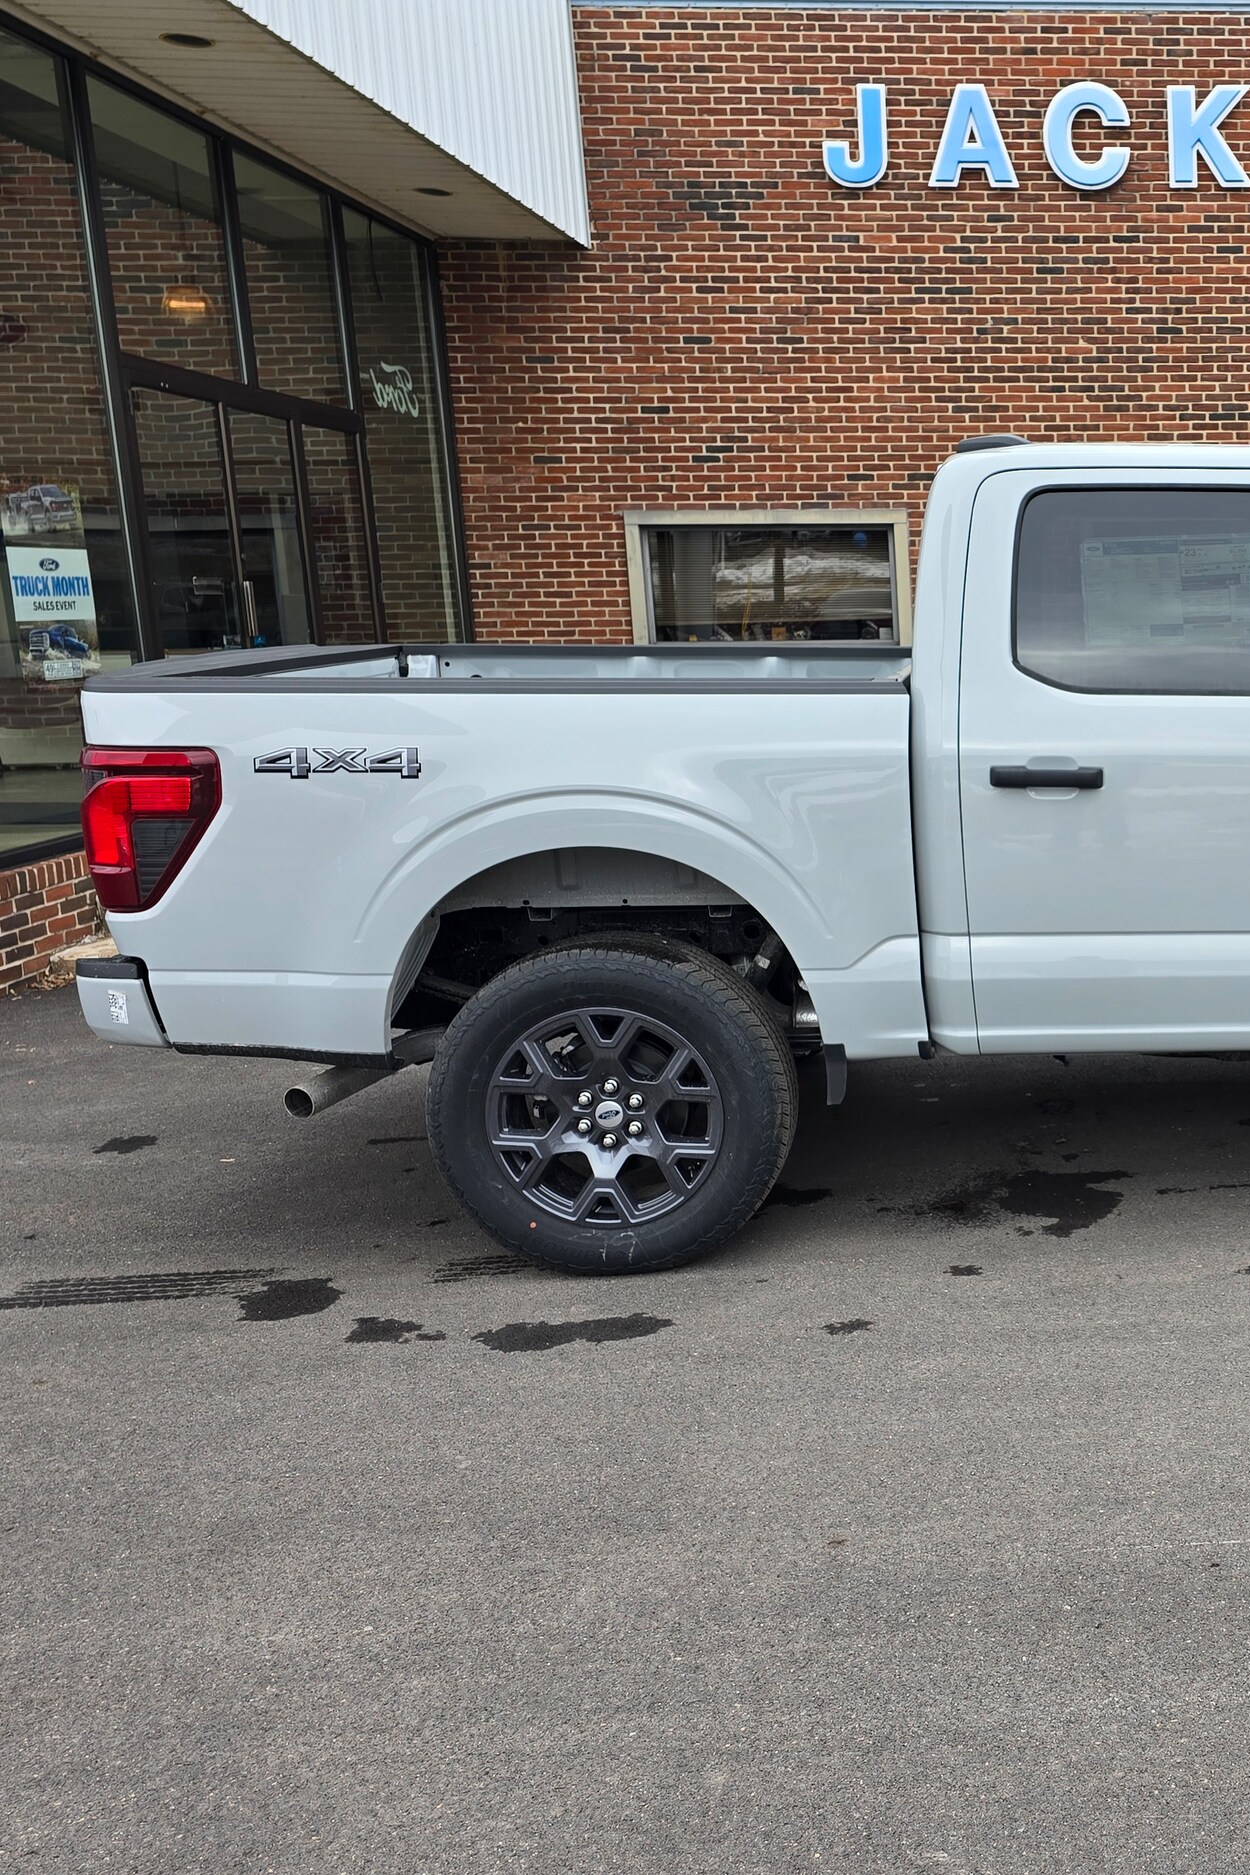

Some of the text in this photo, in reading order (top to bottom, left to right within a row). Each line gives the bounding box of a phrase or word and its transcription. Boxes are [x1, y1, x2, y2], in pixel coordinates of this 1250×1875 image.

[42, 559, 57, 570] Ford
[12, 576, 90, 597] TRUCK MONTH
[33, 601, 76, 612] SALES EVENT
